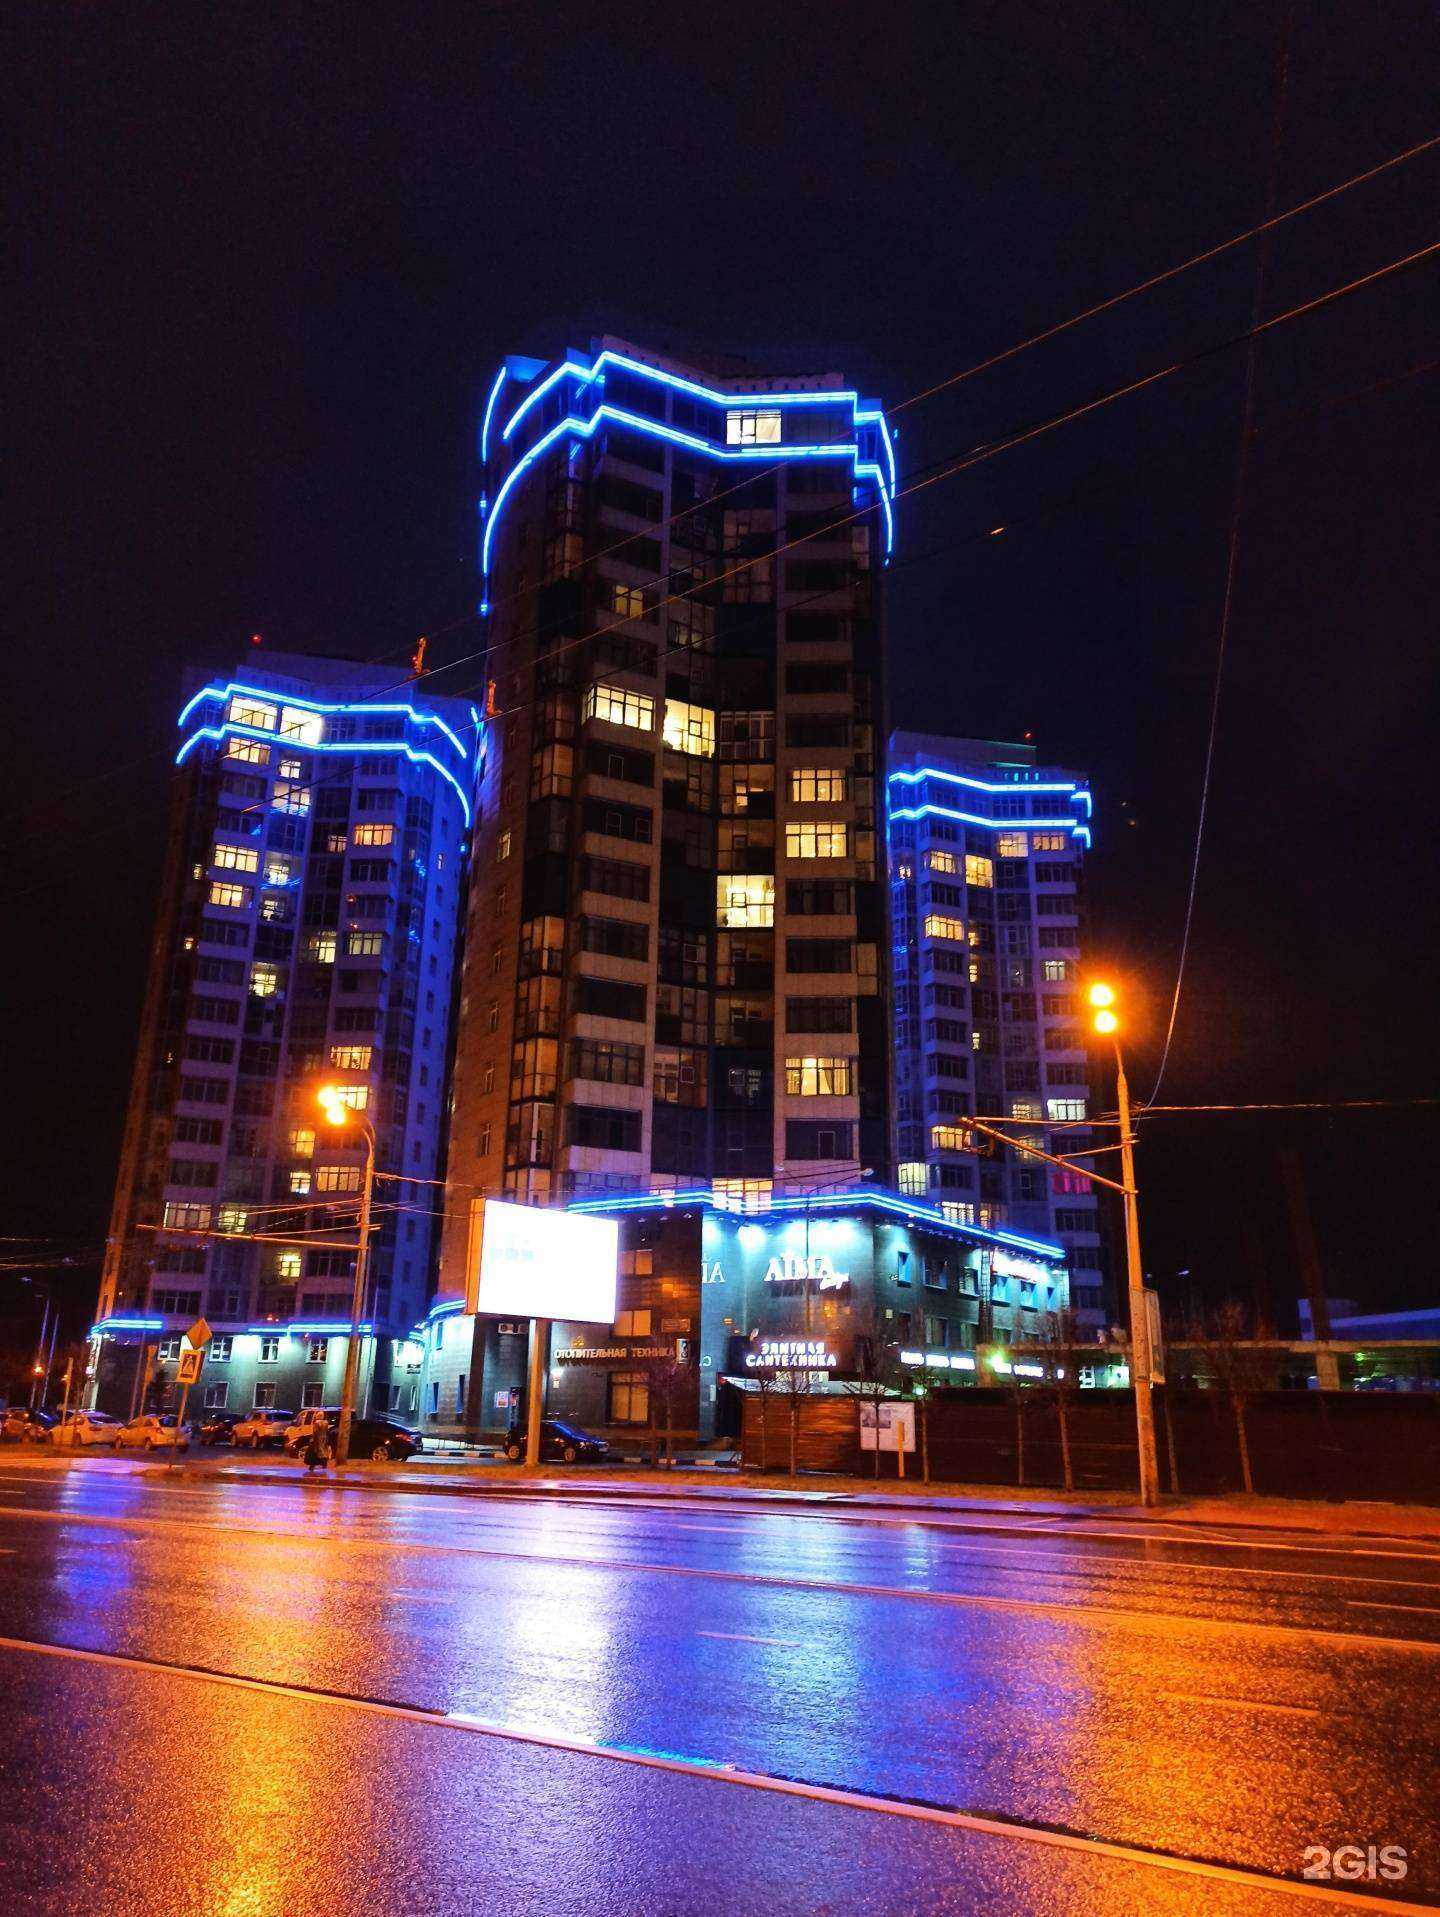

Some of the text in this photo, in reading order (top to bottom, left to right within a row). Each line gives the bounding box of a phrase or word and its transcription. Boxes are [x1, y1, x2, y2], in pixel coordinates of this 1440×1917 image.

[554, 1348, 627, 1359] ОТОПИТЕЛЬНАЯ
[631, 1347, 675, 1358] ТЕХНИКА
[761, 1342, 825, 1355] ЭЛИТНАЯ
[746, 1354, 837, 1367] САНТЕХНИКА
